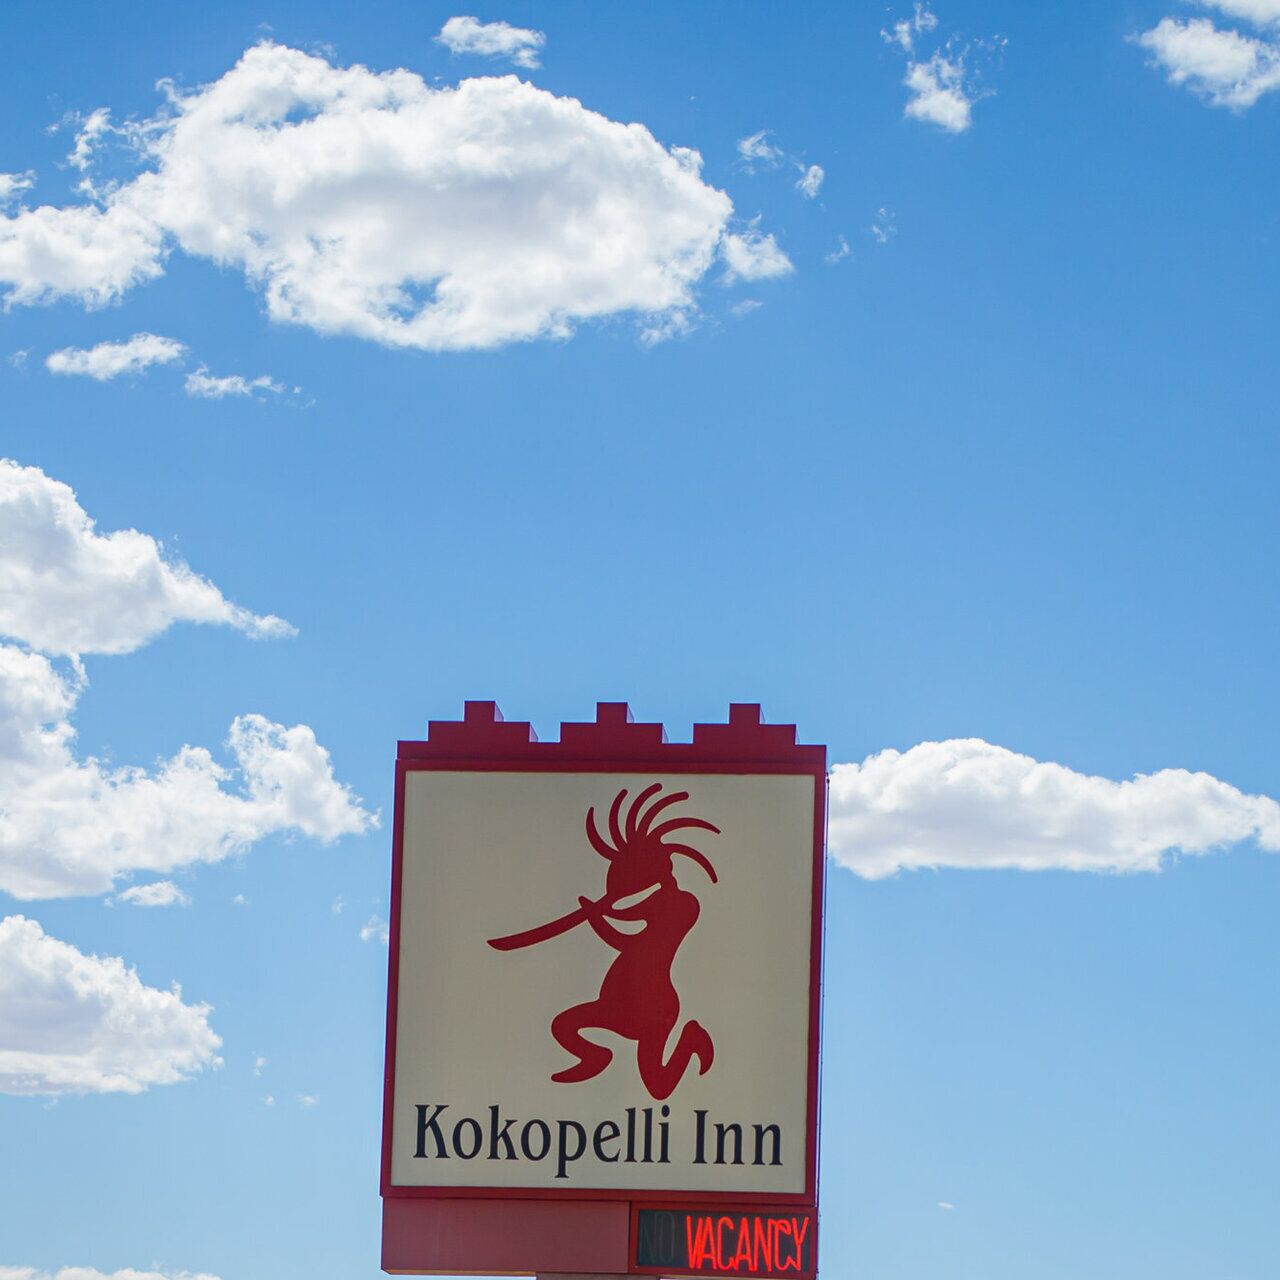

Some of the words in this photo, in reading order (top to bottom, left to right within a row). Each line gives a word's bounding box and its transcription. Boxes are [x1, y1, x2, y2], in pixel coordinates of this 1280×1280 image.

[413, 1104, 671, 1178] Kokopelli
[692, 1109, 784, 1166] Inn
[686, 1215, 810, 1272] VACANCY
